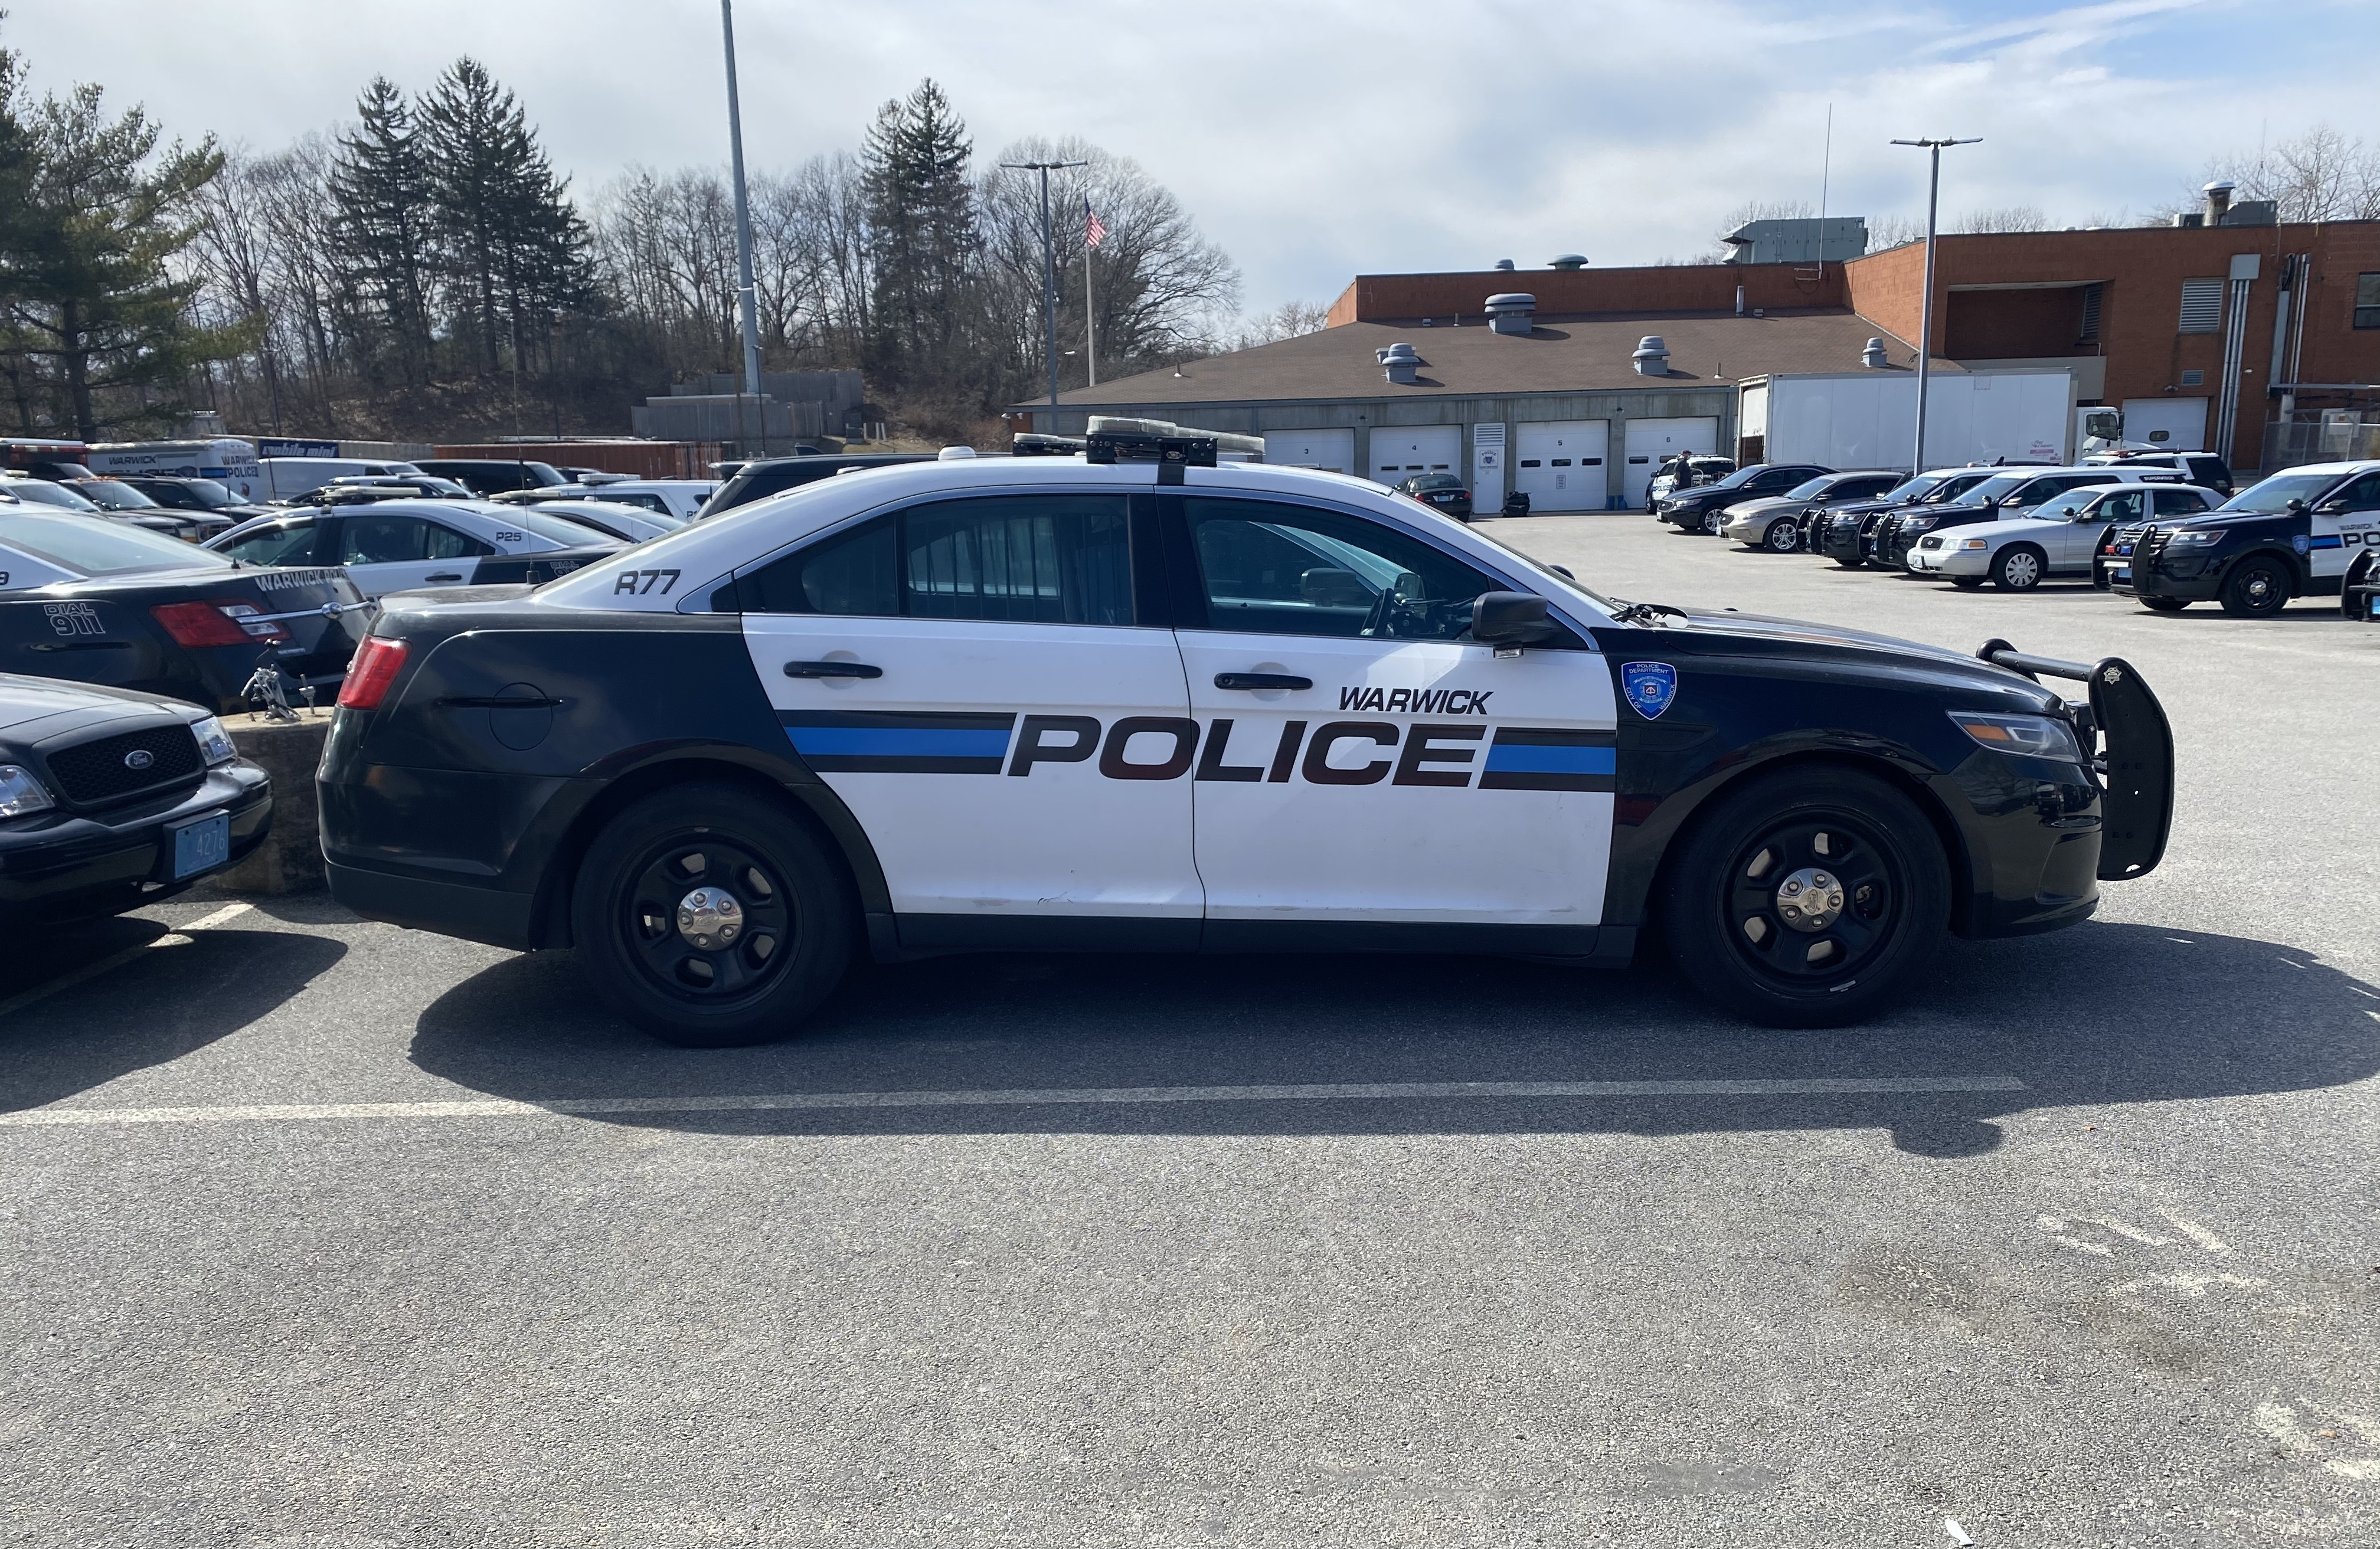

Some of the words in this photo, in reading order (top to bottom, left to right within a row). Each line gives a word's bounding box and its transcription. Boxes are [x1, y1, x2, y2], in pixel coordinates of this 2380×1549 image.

[109, 456, 156, 464] WARWICK
[262, 443, 305, 456] mobile
[306, 446, 338, 457] mini
[227, 466, 259, 478] POLICE
[495, 532, 522, 541] P25
[254, 570, 324, 591] WARWICK
[614, 569, 681, 595] R77
[43, 603, 95, 616] DIAL
[50, 614, 106, 636] 911
[1339, 686, 1494, 715] WARWICK
[1626, 687, 1635, 700] CITY
[1659, 684, 1675, 710] WARWICK
[1008, 715, 1488, 788] POLICE
[197, 828, 225, 857] 4276
